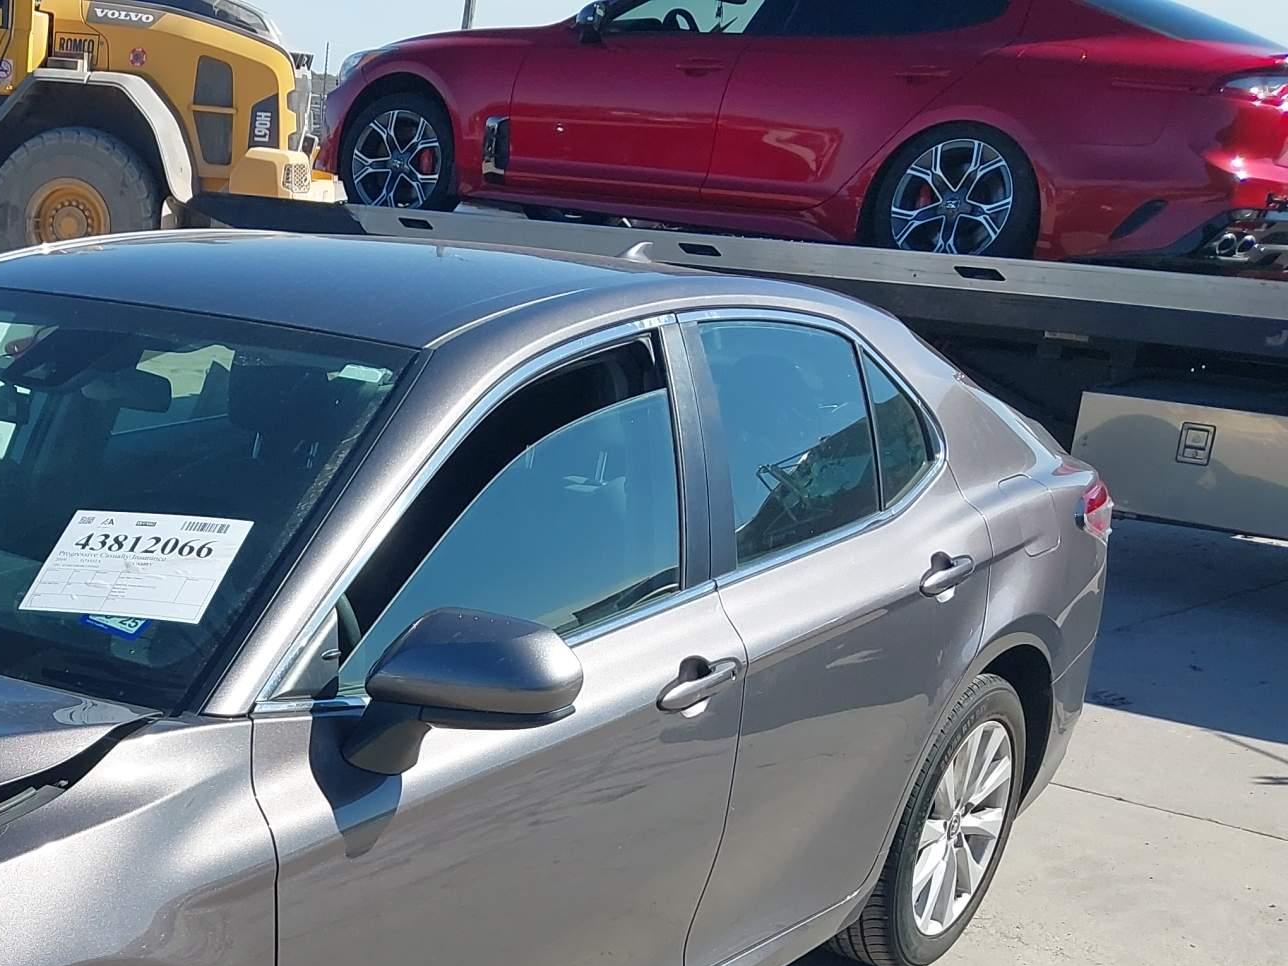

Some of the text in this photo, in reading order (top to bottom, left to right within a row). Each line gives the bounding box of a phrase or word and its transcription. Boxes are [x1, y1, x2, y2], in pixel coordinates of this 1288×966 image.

[94, 8, 154, 23] VOLVO
[253, 111, 272, 142] L90H
[74, 532, 216, 558] 43812066
